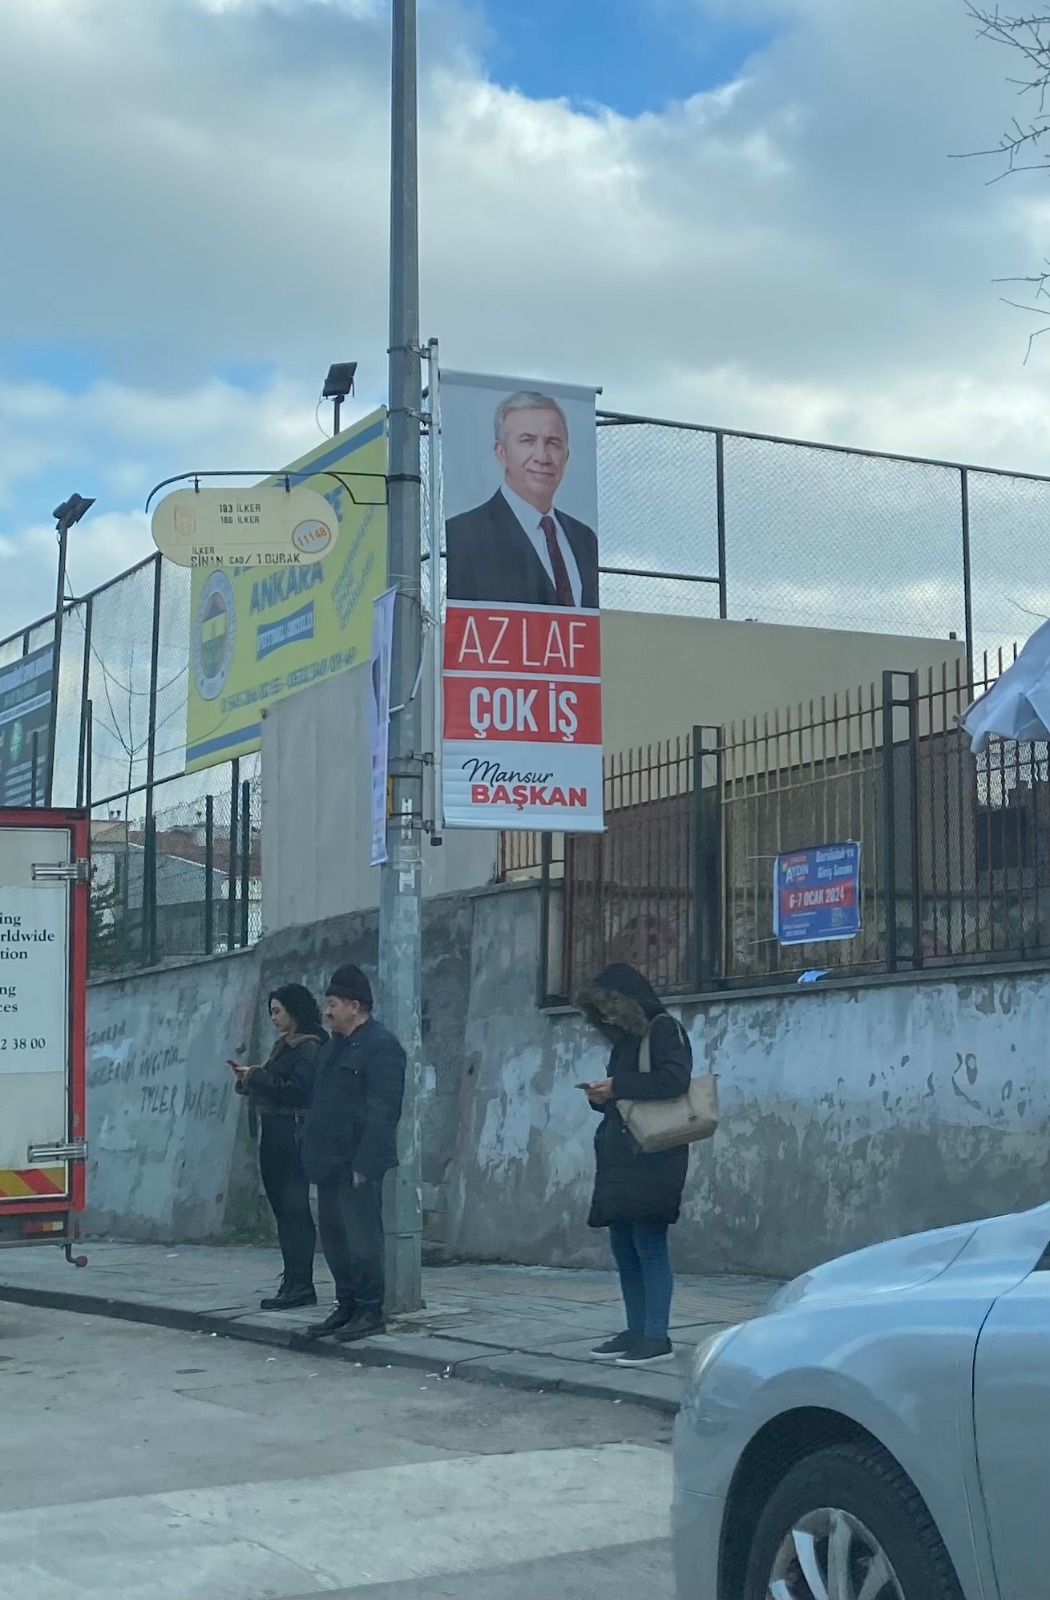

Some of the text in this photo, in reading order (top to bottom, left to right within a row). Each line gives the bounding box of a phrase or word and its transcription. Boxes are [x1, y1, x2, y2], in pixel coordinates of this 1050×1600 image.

[236, 502, 261, 513] İLKER
[237, 515, 260, 524] İLKER
[298, 527, 327, 546] 11148
[192, 546, 215, 554] İLKER
[250, 559, 325, 616] ANKARA
[458, 615, 587, 669] AZ LAF
[469, 682, 578, 742] ÇOK İŞ
[462, 758, 554, 787] Mansur
[471, 784, 588, 811] BAŞKAN
[803, 889, 824, 907] OCAK
[825, 885, 845, 904] 2024
[12, 1038, 27, 1050] 38
[30, 1037, 46, 1049] 00
